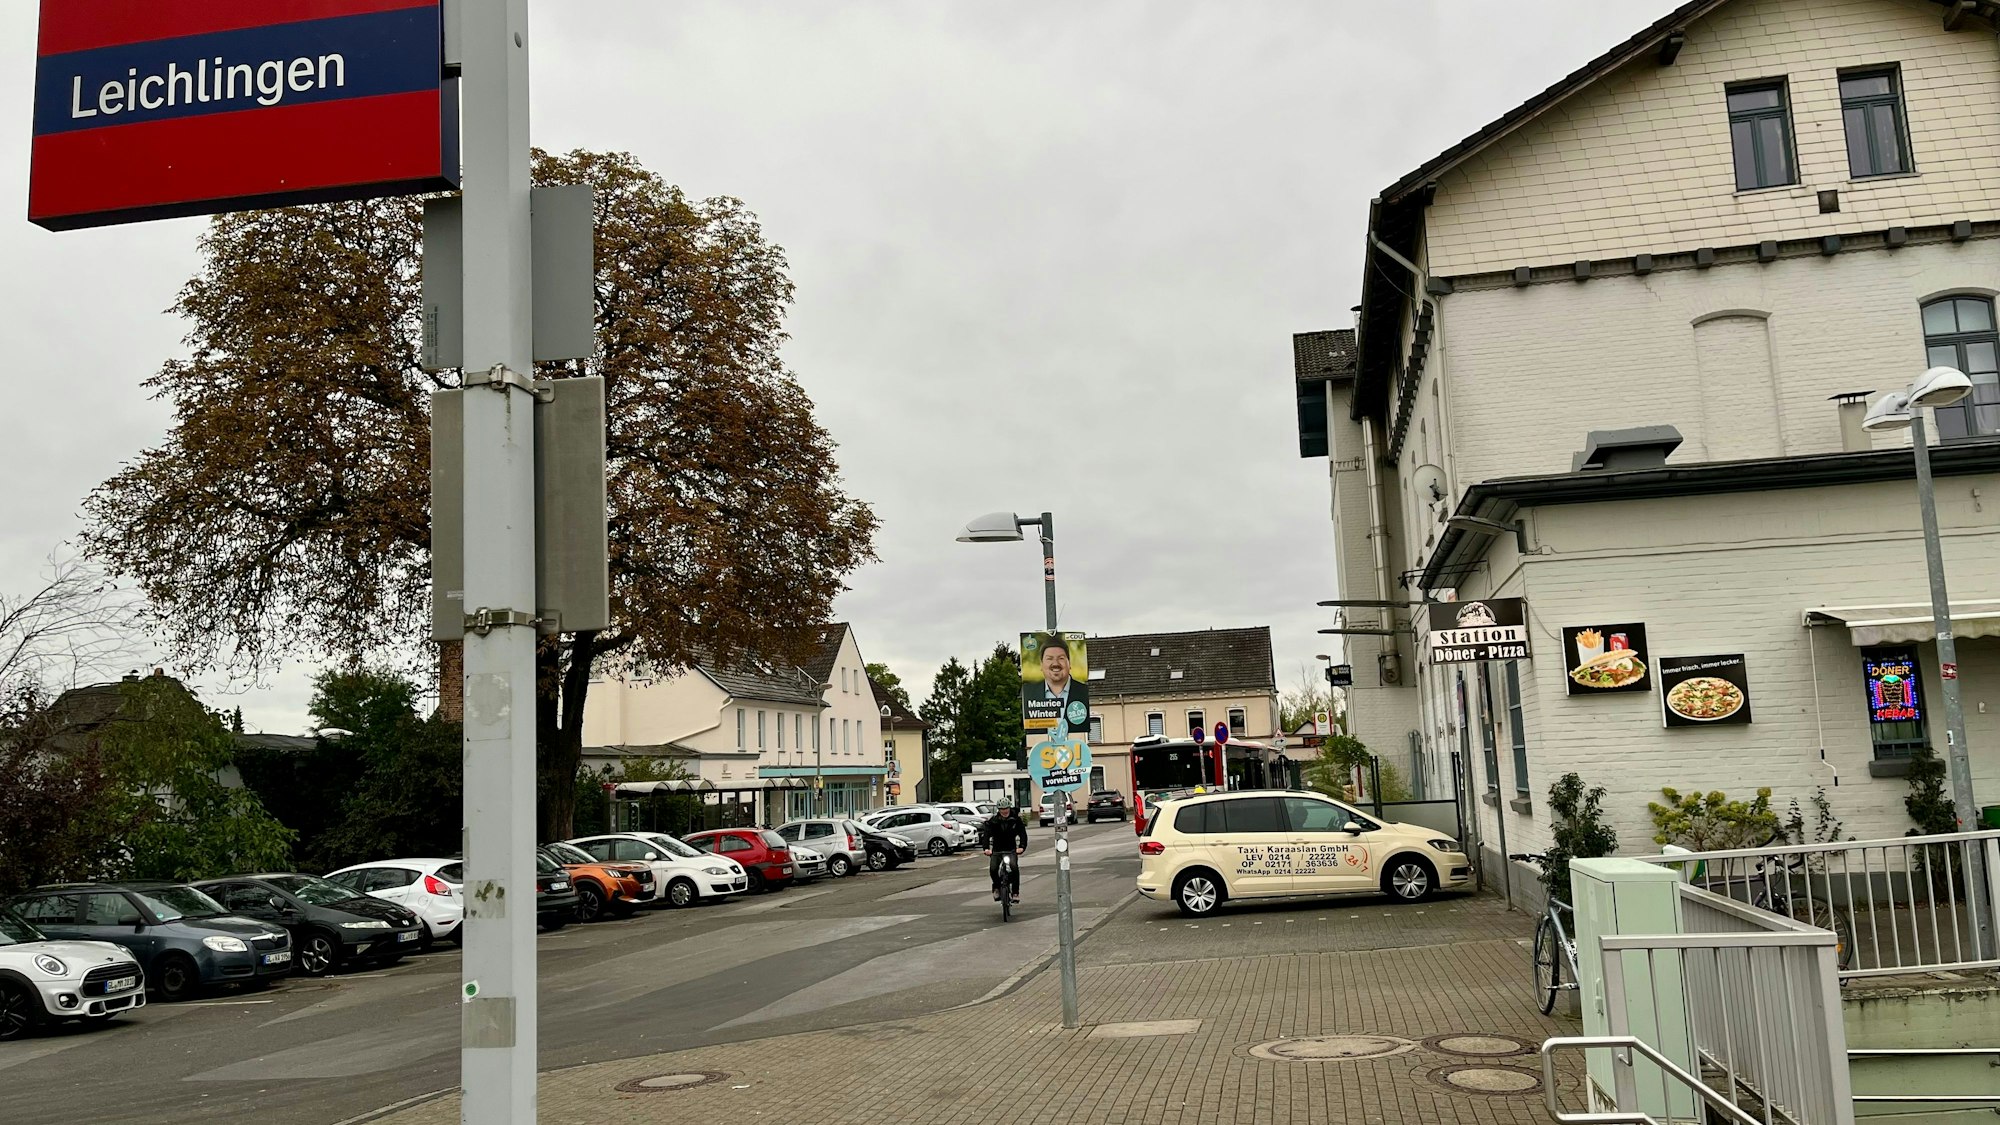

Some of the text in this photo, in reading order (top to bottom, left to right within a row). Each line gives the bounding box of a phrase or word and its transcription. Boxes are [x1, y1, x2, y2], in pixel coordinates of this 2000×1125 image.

[72, 53, 345, 119] Leichlingen
[1440, 629, 1516, 645] Station
[1435, 647, 1477, 662] Döner
[1487, 645, 1526, 659] Pizza
[1662, 667, 1682, 675] Immer
[1681, 664, 1701, 673] frisch,
[1701, 661, 1720, 669] immer
[1028, 699, 1062, 708] Maurice
[1028, 709, 1057, 718] Winter
[1876, 708, 1916, 719] KEBAB
[1045, 775, 1078, 786] vorwärts
[1237, 846, 1258, 854] Taxi
[1267, 845, 1317, 853] Karaaslan
[1320, 845, 1349, 853] GmbH
[1268, 853, 1291, 861] 0214
[1265, 860, 1291, 868] 02171
